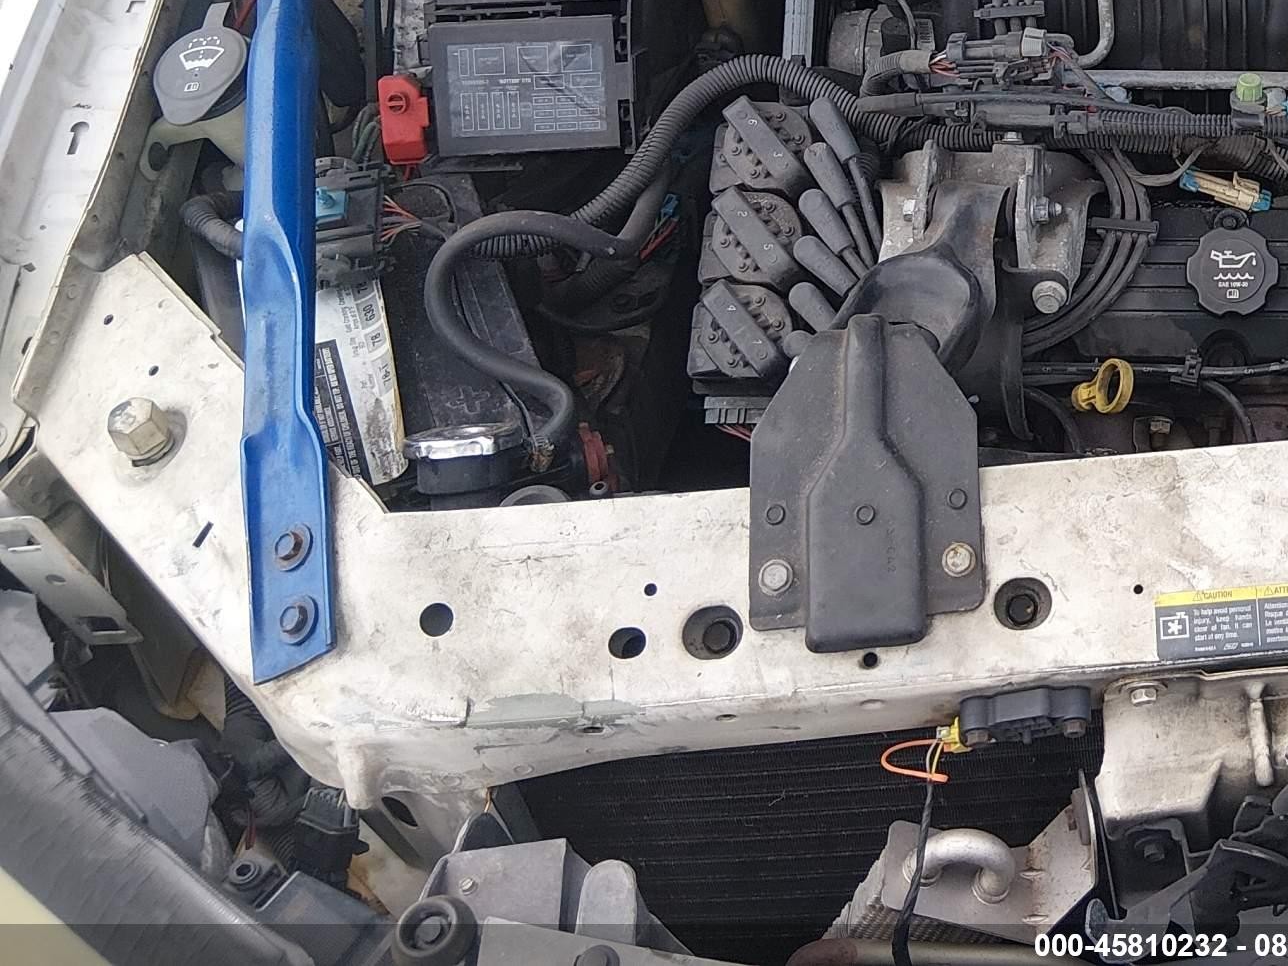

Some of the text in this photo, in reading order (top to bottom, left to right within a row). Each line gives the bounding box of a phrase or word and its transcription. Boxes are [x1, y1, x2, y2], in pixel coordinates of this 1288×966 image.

[748, 118, 758, 128] 6
[737, 210, 748, 219] 2
[763, 242, 774, 251] 5
[361, 303, 376, 321] 630
[369, 332, 382, 346] 78
[1203, 590, 1232, 600] CAUTION
[1263, 600, 1288, 609] Attention
